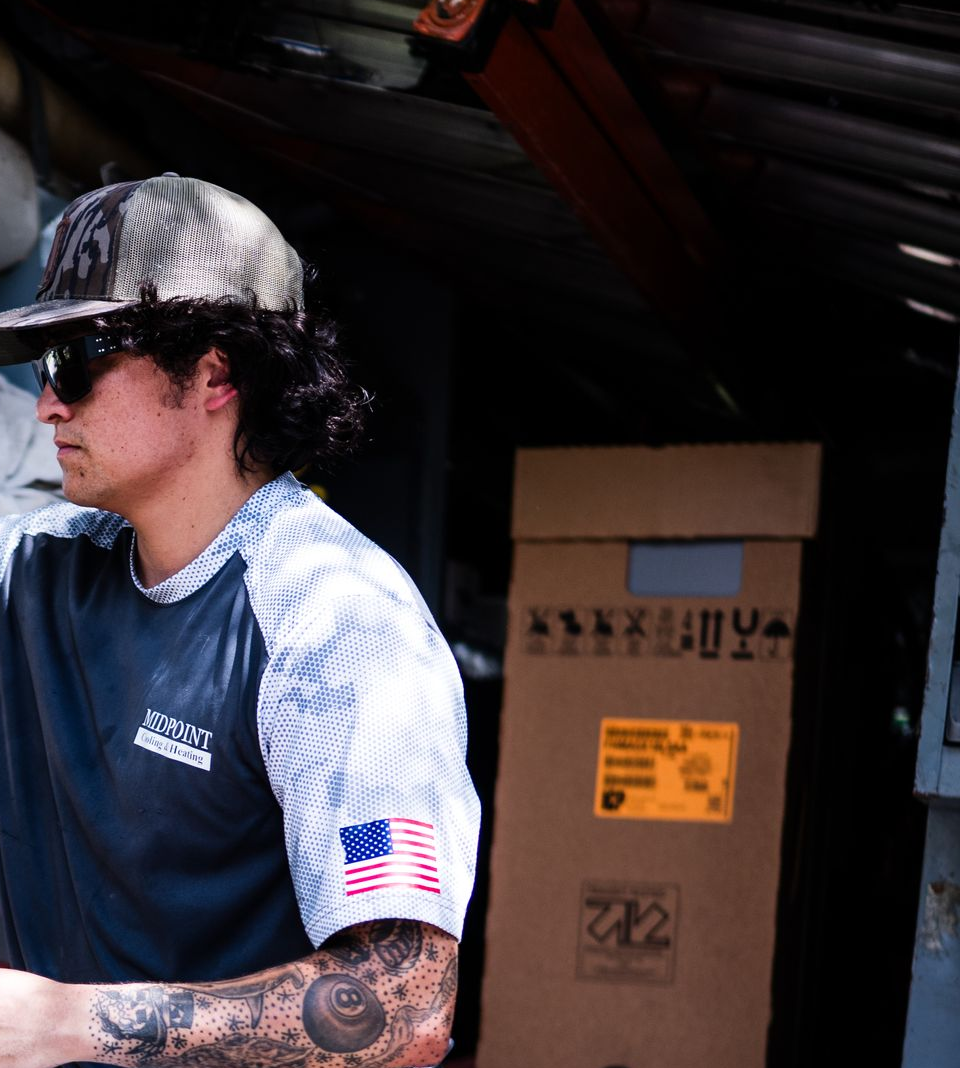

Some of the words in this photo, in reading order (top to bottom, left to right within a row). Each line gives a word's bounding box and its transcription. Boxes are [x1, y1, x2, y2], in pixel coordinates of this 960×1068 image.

[142, 708, 213, 750] MIDPOINT
[169, 744, 204, 764] Heating
[336, 988, 362, 1008] 8
